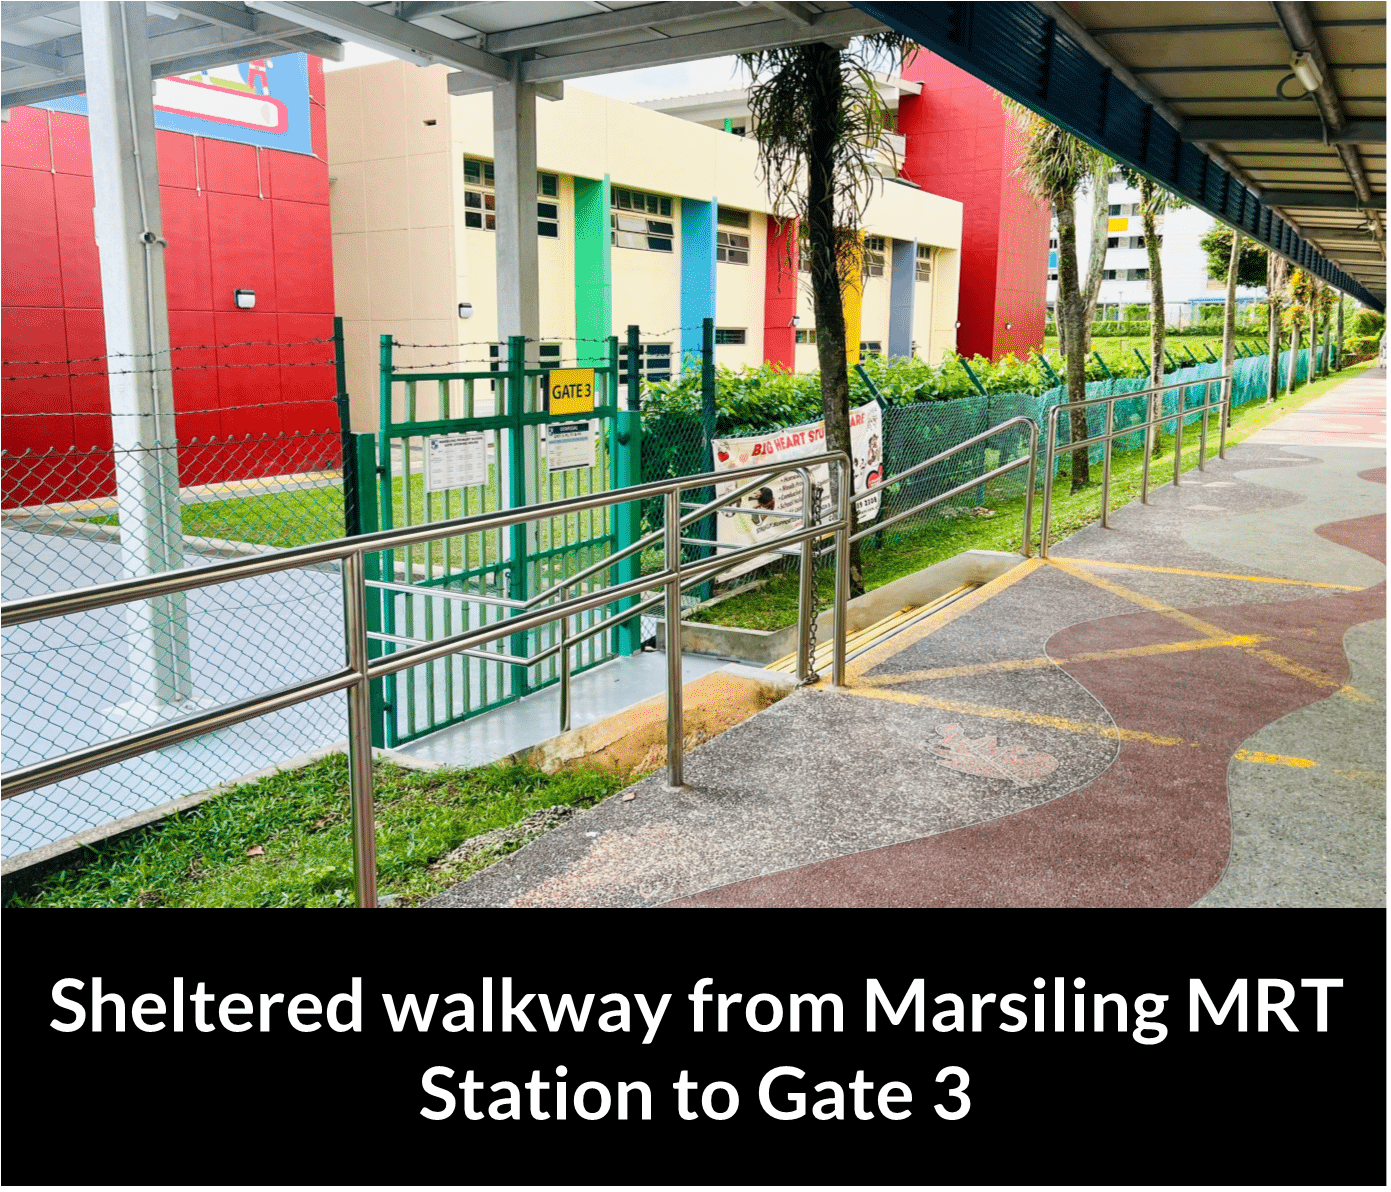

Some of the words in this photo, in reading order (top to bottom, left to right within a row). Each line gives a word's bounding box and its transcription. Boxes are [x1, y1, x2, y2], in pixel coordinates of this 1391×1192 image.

[552, 384, 583, 399] GATE
[584, 384, 591, 398] 3
[752, 442, 774, 457] BIG
[774, 432, 805, 453] HEART
[809, 426, 825, 443] STU
[850, 412, 865, 428] ARE
